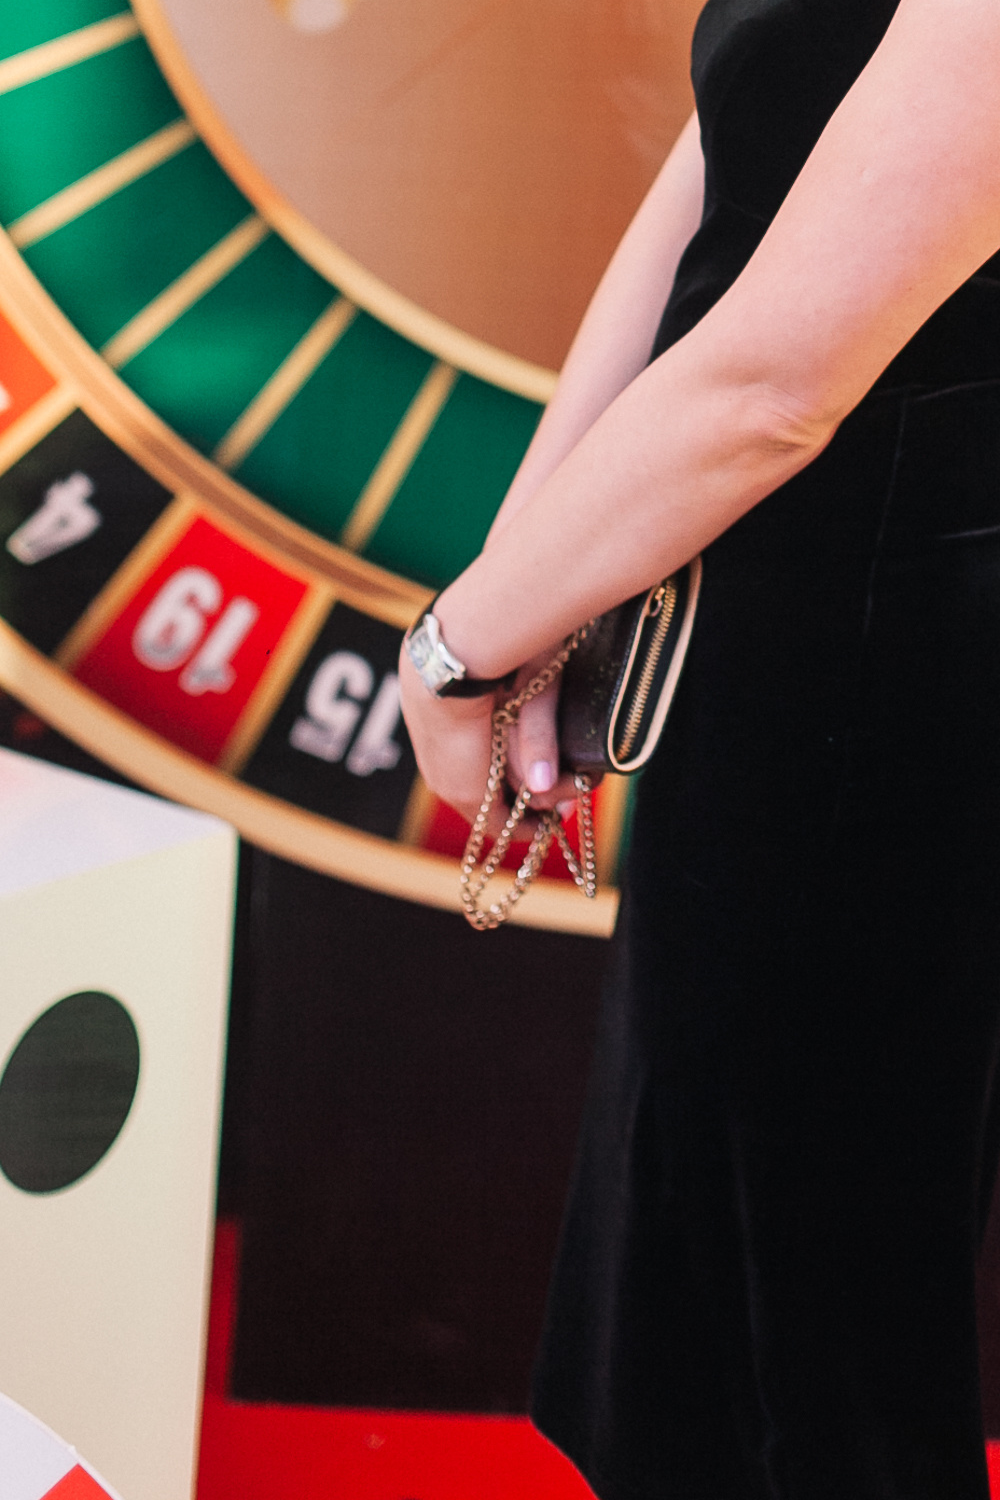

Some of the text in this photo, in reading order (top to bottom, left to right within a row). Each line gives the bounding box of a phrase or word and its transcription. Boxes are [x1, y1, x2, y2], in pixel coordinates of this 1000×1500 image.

[5, 471, 100, 565] 4
[131, 566, 258, 695] 19
[289, 650, 401, 777] 15
